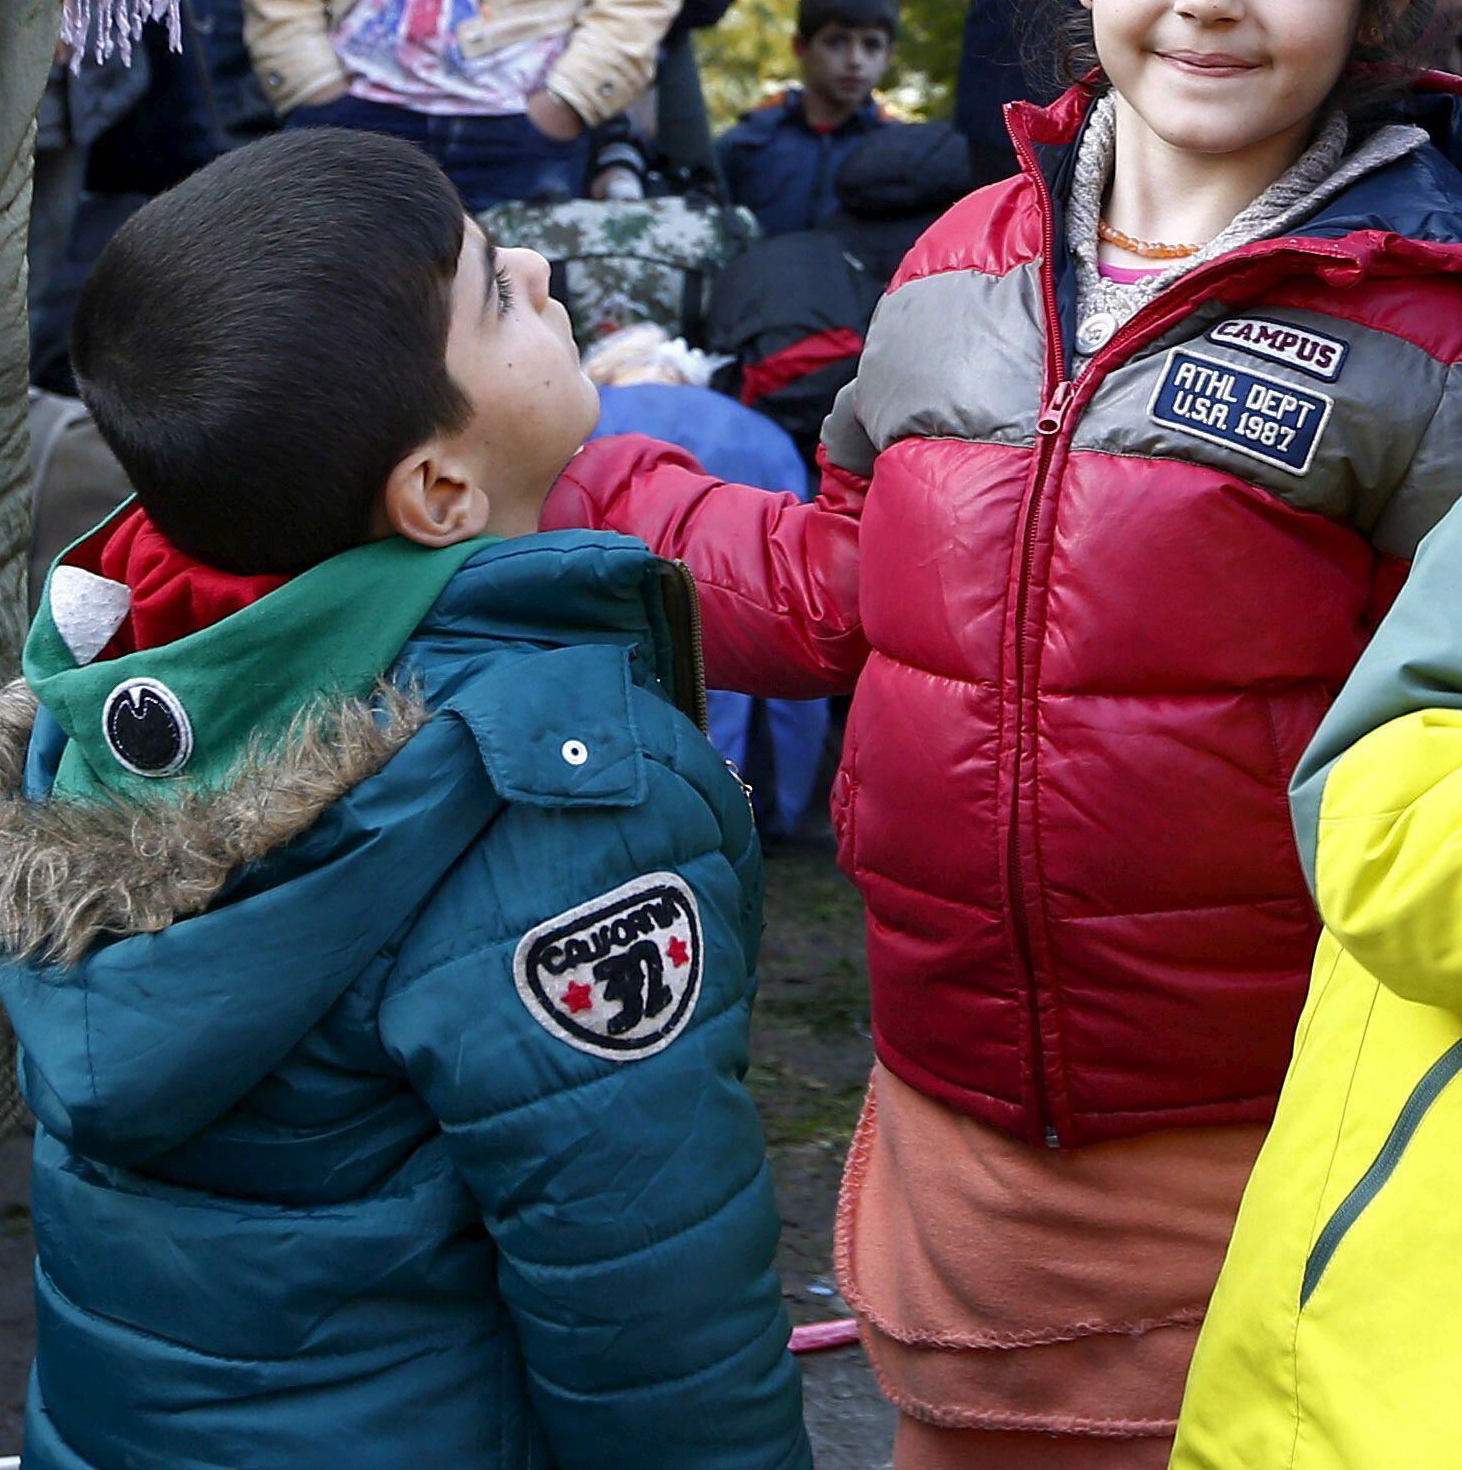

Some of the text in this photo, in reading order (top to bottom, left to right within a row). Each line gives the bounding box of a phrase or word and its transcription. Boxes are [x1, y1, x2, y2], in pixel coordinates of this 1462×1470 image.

[1217, 323, 1336, 368] CAMPUS
[1174, 363, 1316, 428] ATHL DEPT
[1236, 412, 1295, 452] 1987
